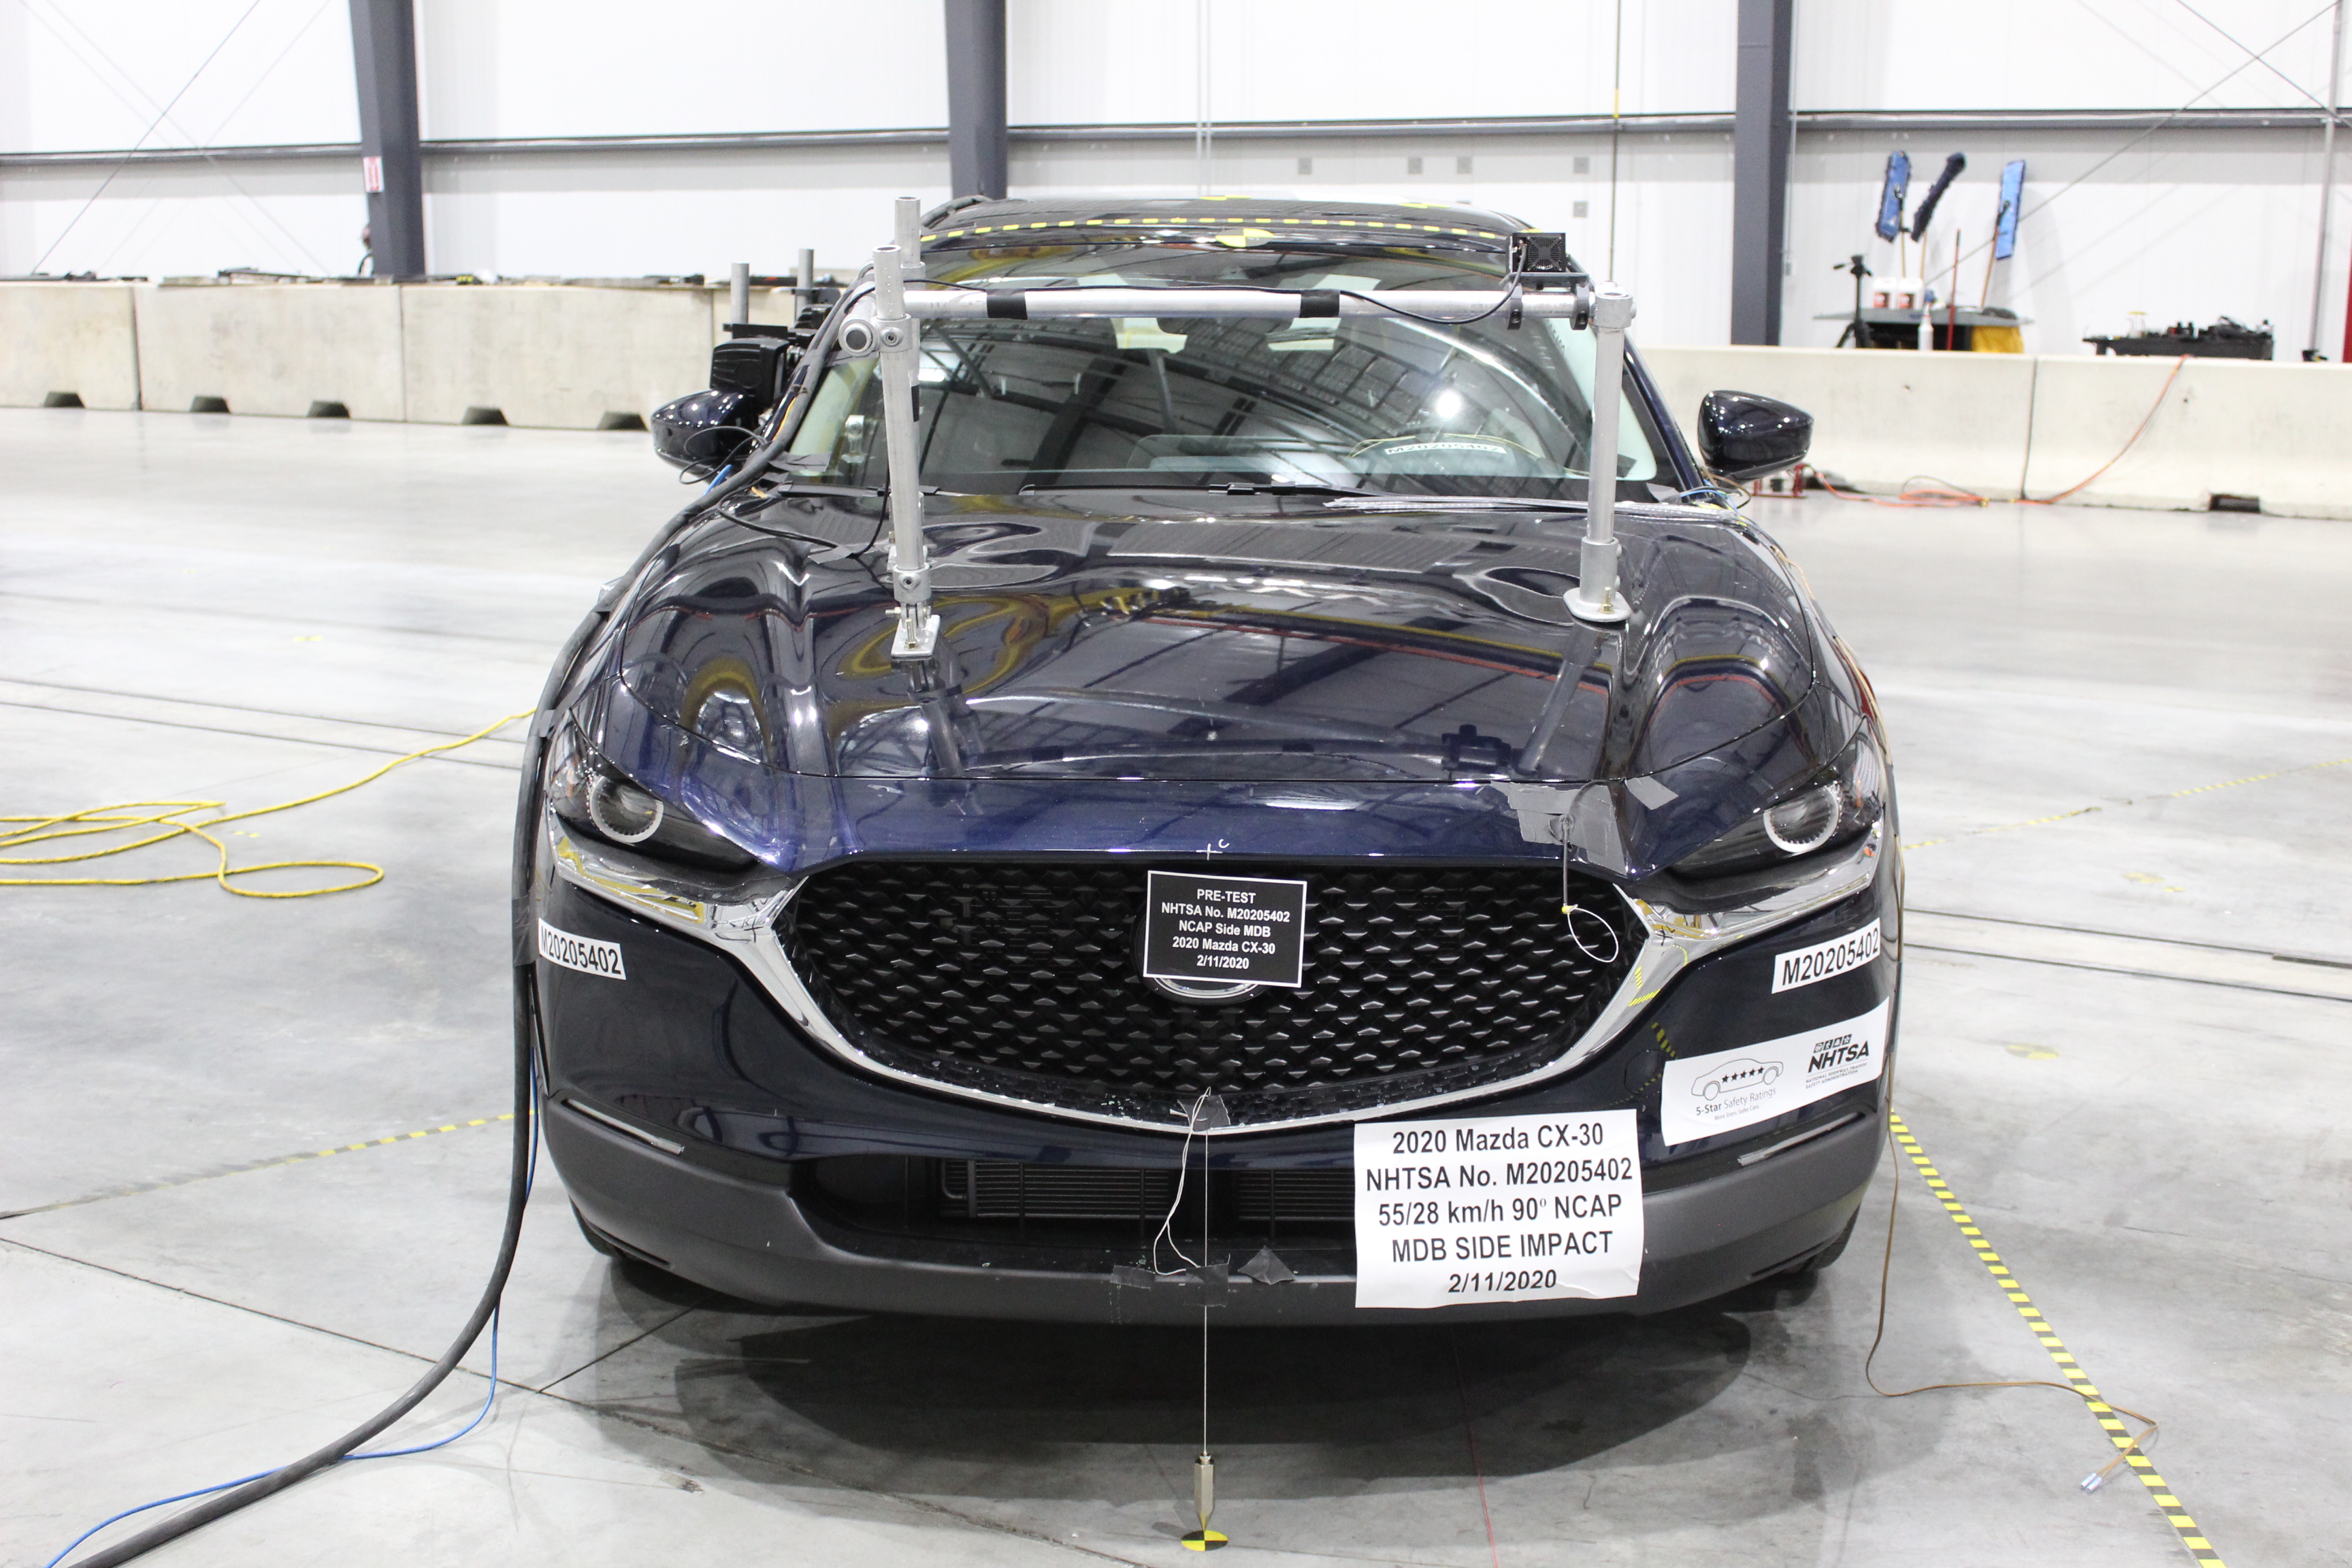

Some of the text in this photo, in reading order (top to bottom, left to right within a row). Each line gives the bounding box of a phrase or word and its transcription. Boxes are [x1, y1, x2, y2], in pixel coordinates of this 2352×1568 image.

[1388, 444, 1499, 453] M20205402
[1196, 889, 1256, 904] PRE-TEST
[1162, 902, 1290, 922] NHTSA No. M20205402
[1179, 920, 1271, 938] NCAP Side MDB
[541, 926, 621, 975] M20205402
[1172, 936, 1276, 954] 2020 Mazda CX-30
[1782, 927, 1879, 986] M20205402
[1196, 955, 1250, 969] 2/11/2020
[1808, 1041, 1869, 1073] NHTSA
[1806, 1073, 1827, 1083] NATIONAL
[1828, 1067, 1848, 1077] HIGHWAY
[1806, 1069, 1859, 1089] SAFETY ADMINISTRATION
[1696, 1088, 1776, 1115] 5-Star Safety Ratings
[1392, 1123, 1603, 1154] 2020 Mazda CX-30
[1367, 1157, 1633, 1191] NHTSA No. M20205402
[1379, 1201, 1439, 1226] 55/28
[1448, 1199, 1503, 1224] km/h
[1554, 1194, 1622, 1219] NCAP
[1392, 1230, 1613, 1262] MDB SIDE IMPACT
[1448, 1269, 1556, 1293] 2/11/2020
